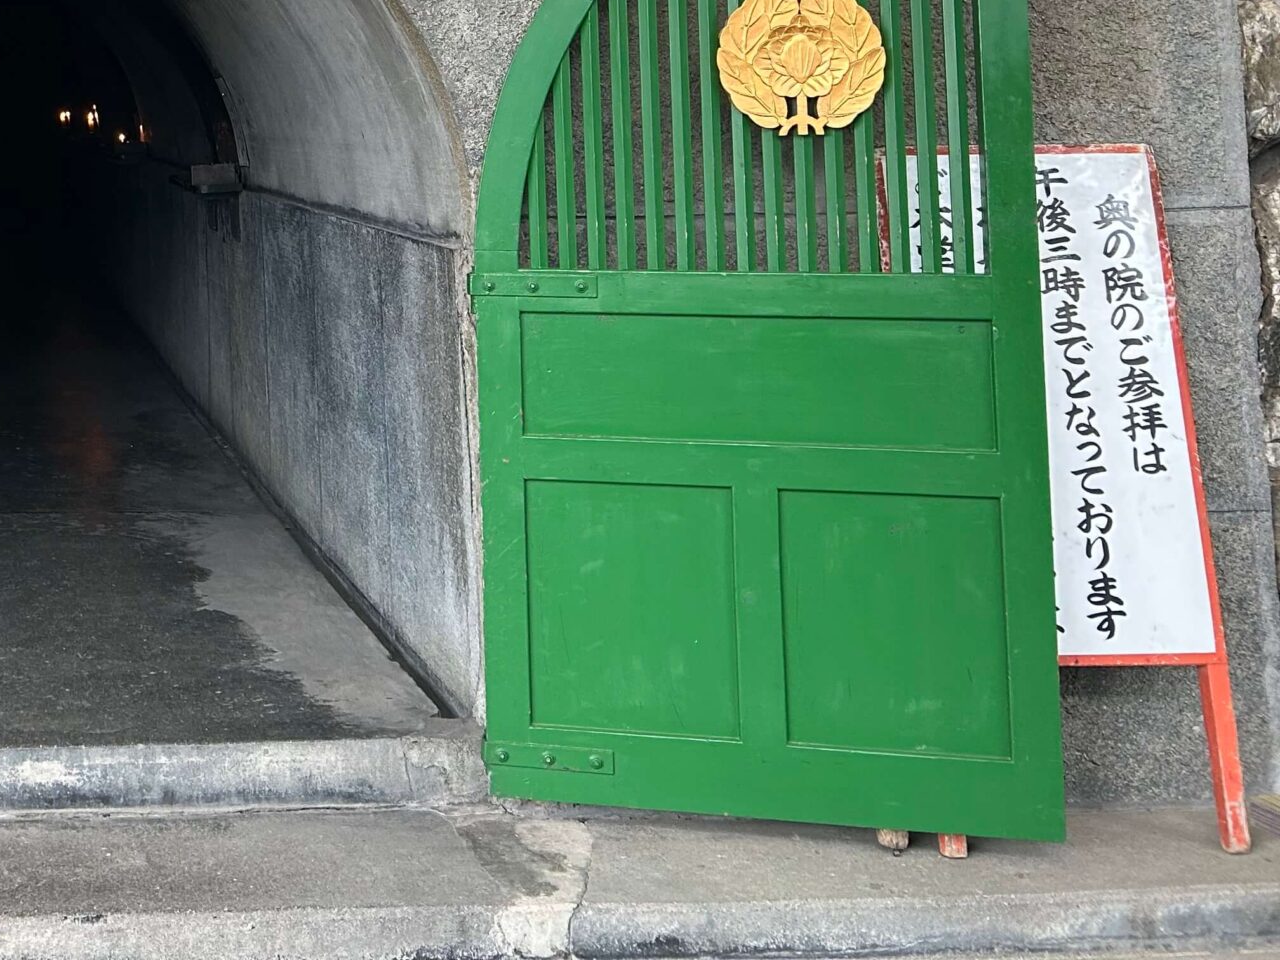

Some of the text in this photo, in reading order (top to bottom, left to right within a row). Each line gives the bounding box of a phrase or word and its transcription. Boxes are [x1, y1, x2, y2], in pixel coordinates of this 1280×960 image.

[1093, 193, 1168, 474] 奥の院のご参拝は
